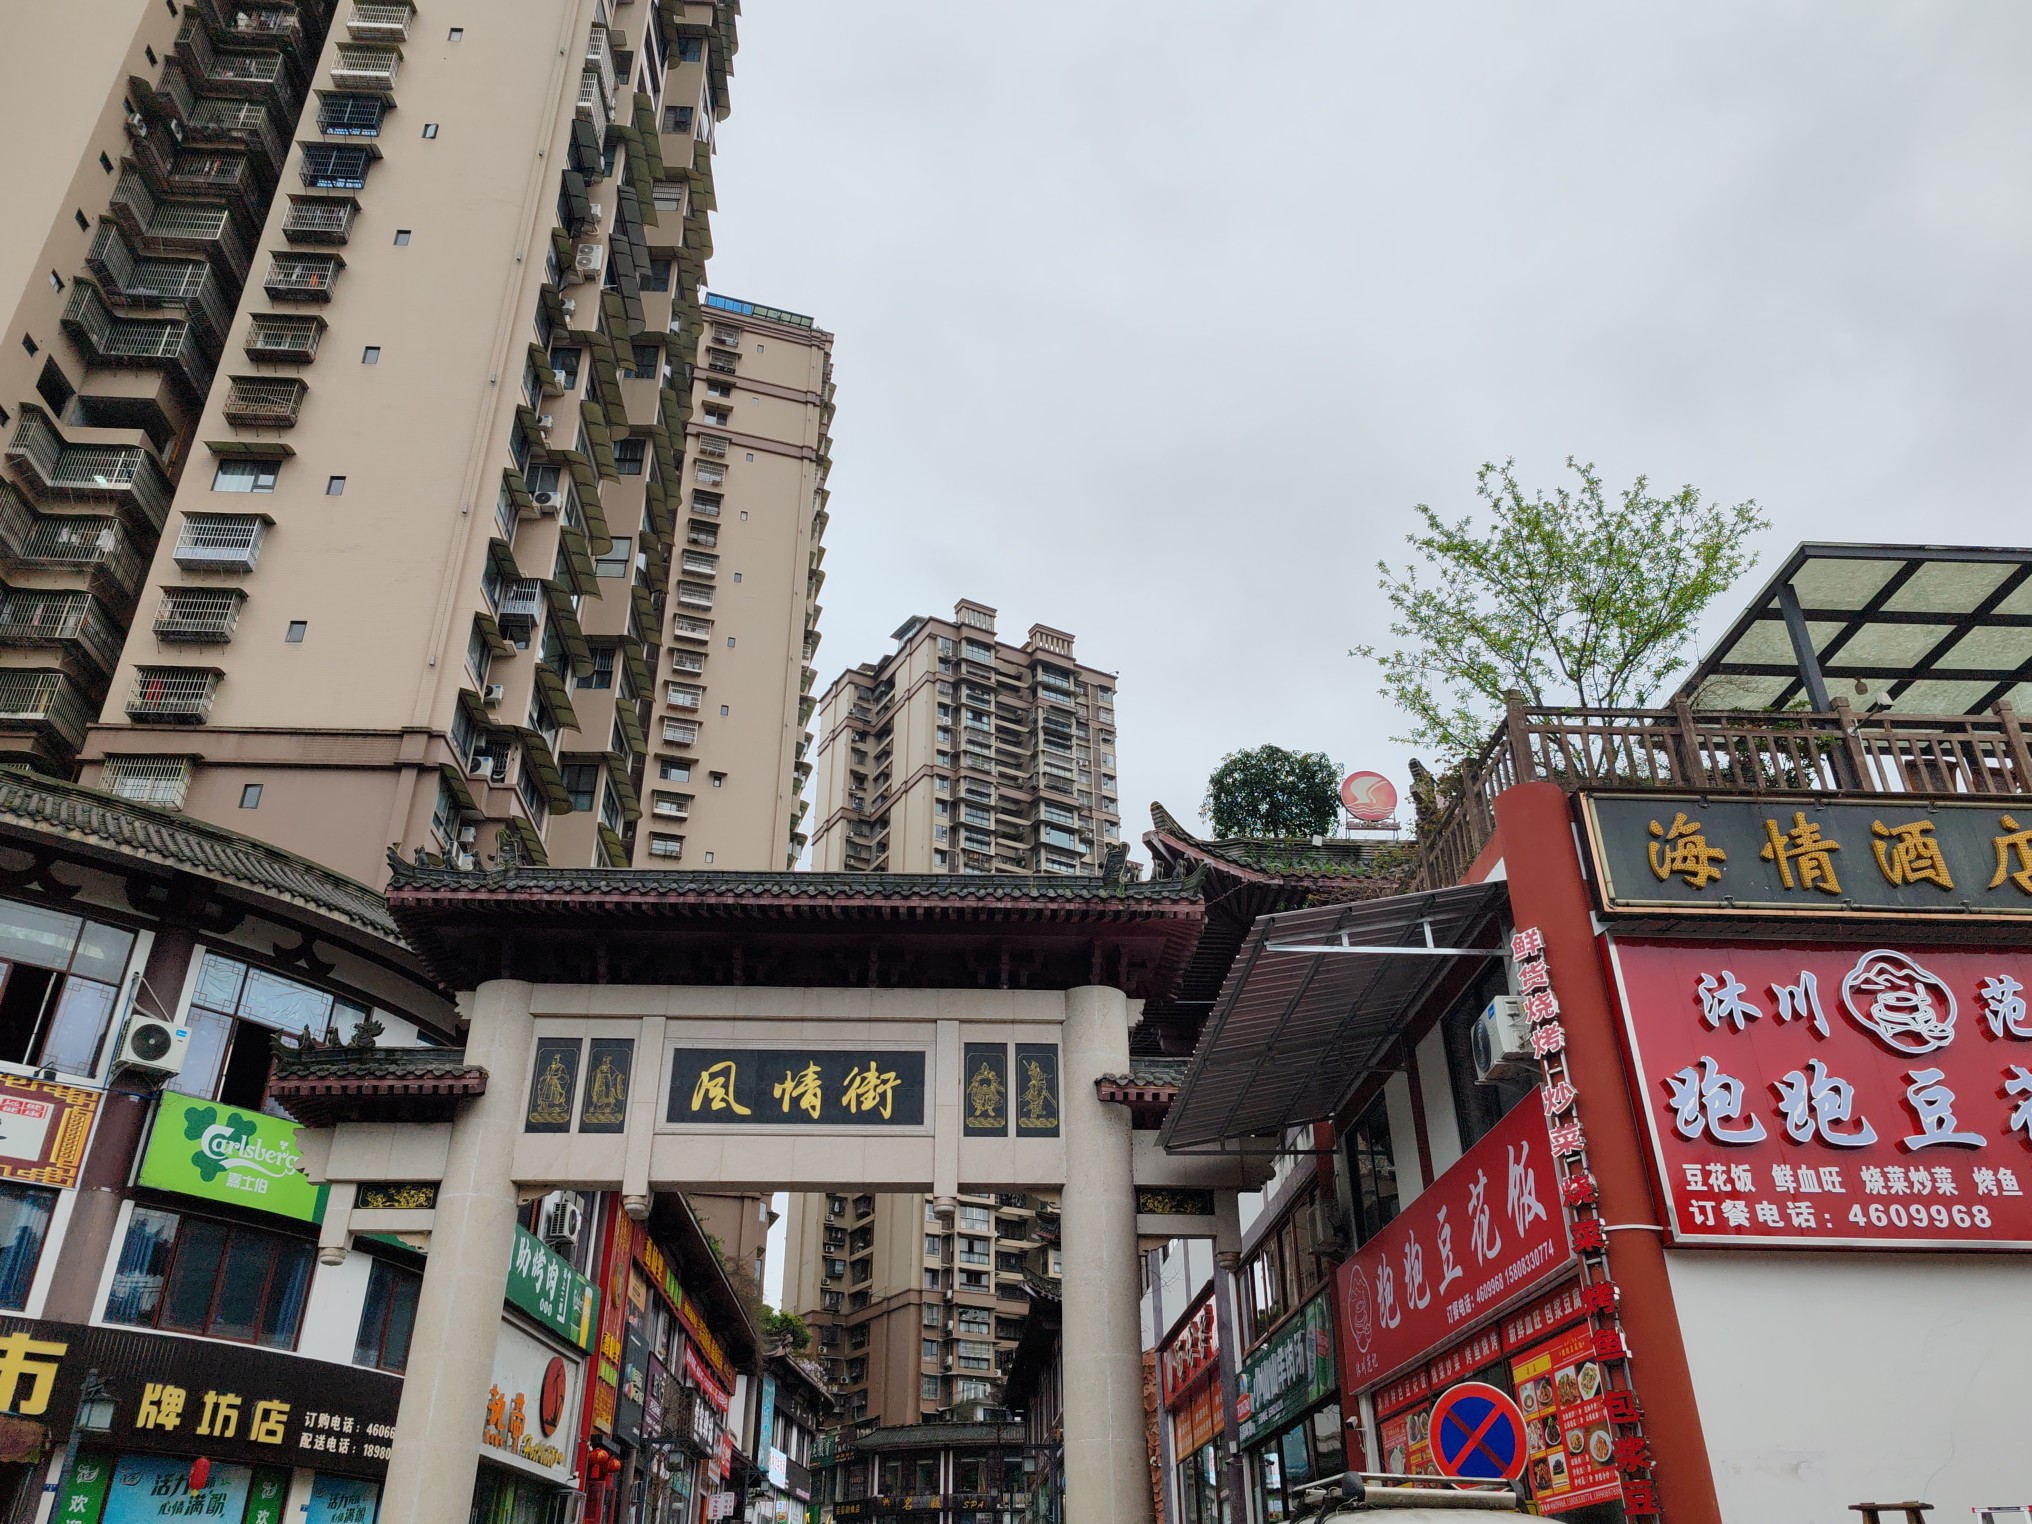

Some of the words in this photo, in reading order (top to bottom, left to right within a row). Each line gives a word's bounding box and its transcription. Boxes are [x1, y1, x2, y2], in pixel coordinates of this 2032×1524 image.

[1697, 970, 1830, 1037] 沐川
[201, 1123, 301, 1176] Carlsberg
[226, 1172, 268, 1194] 嘉士伯
[1682, 1163, 1756, 1193] 豆花饭
[1771, 1164, 1846, 1194] 鲜血旺
[1860, 1166, 1959, 1196] 烧菜炒菜
[1972, 1166, 2024, 1196] 烤鱼
[1848, 1203, 1993, 1229] 4609968
[1476, 1273, 1504, 1304] 4609968
[1505, 1238, 1554, 1286] 15808330774
[136, 1382, 291, 1445] 牌坊店
[363, 1443, 392, 1461] 18980
[963, 1500, 985, 1510] SPA
